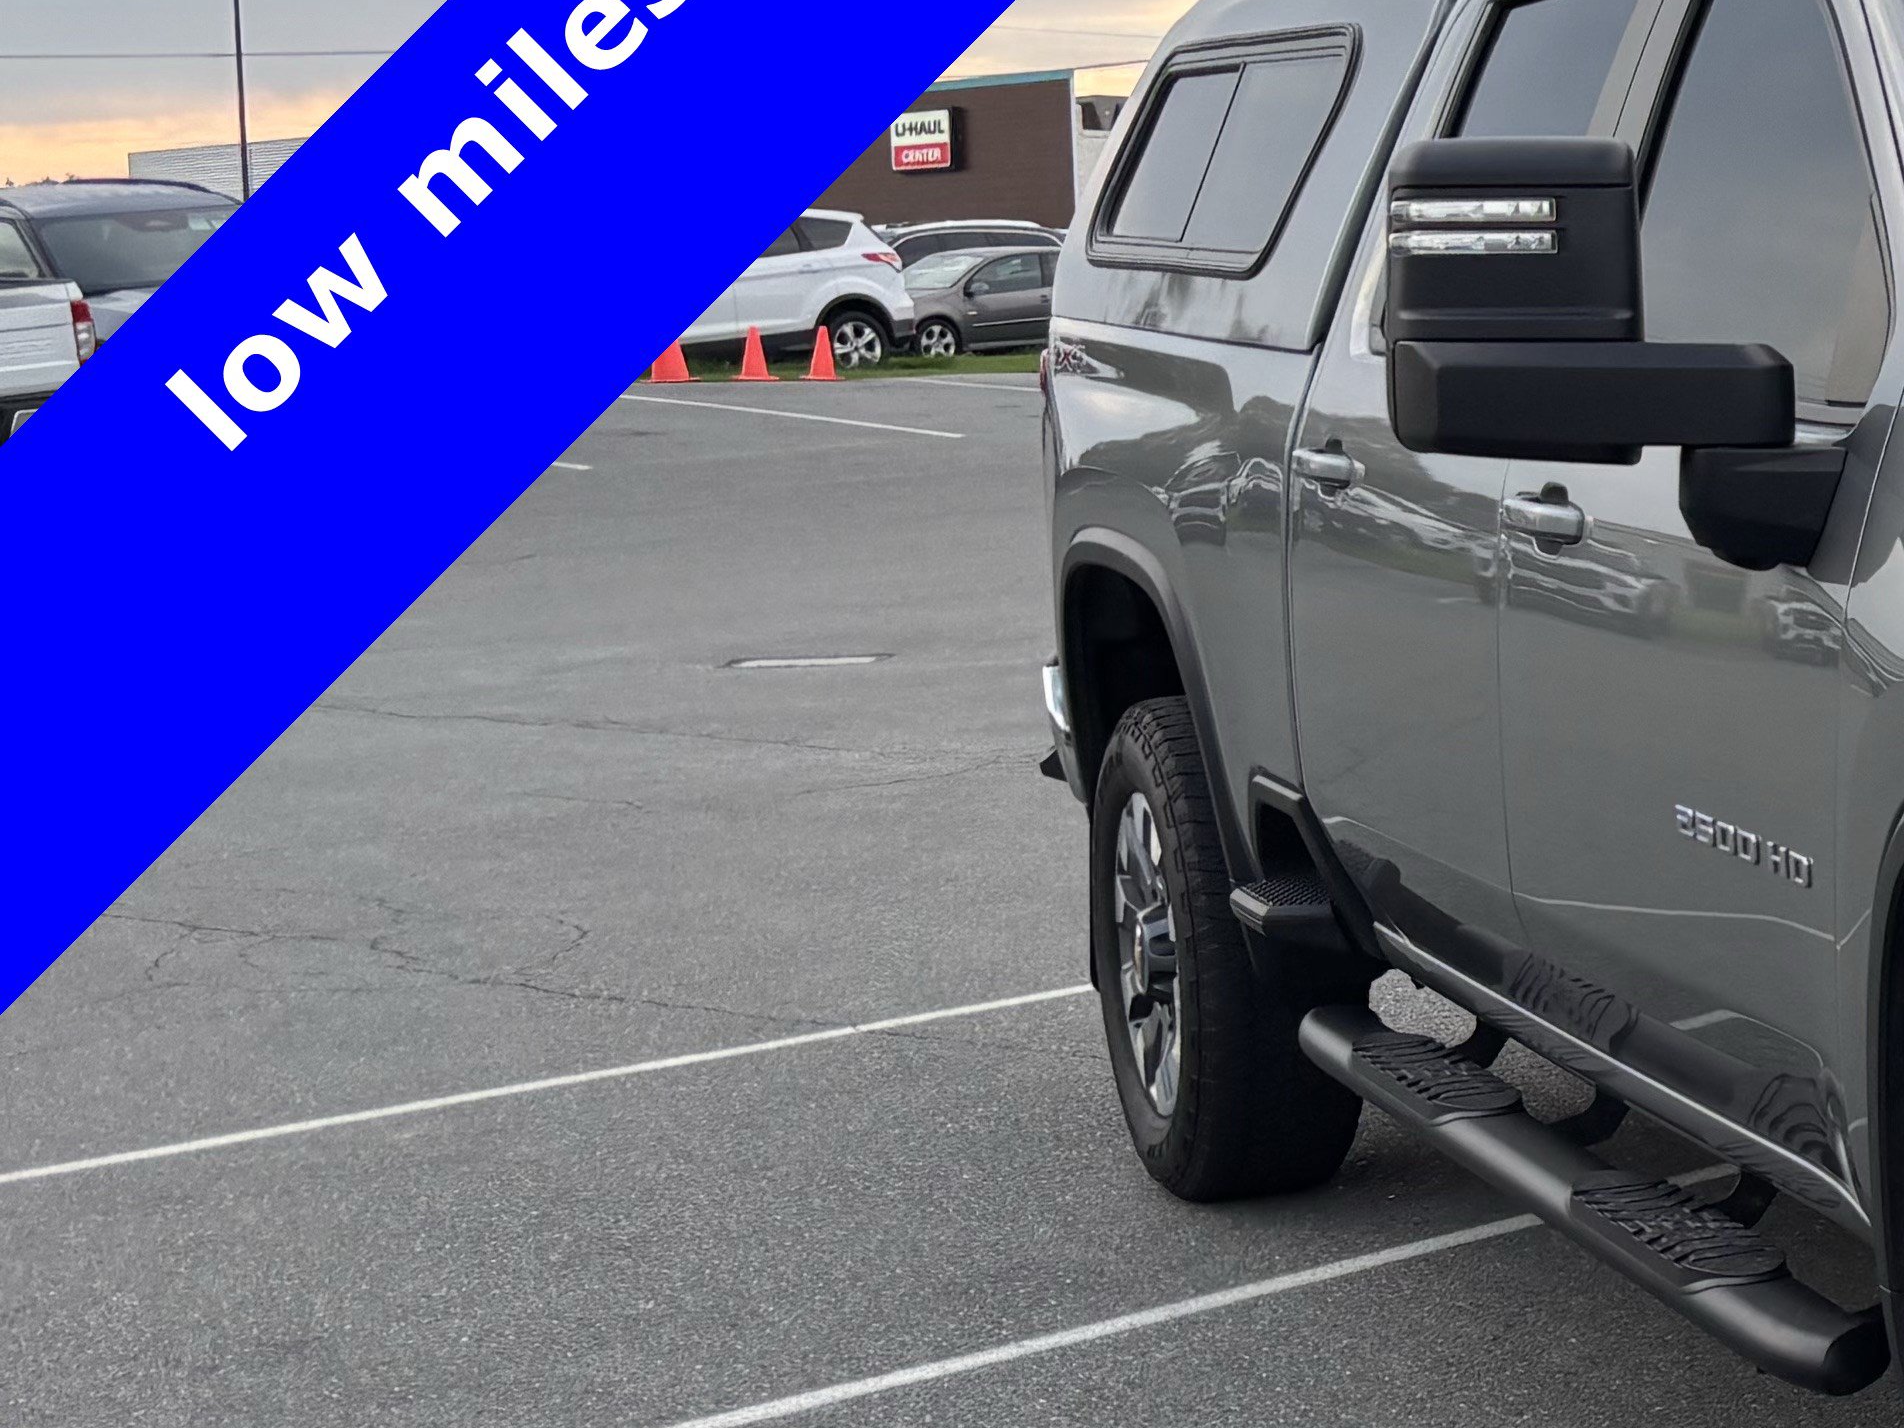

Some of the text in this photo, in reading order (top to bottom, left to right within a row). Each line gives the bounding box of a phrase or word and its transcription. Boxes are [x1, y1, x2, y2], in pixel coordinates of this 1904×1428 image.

[894, 118, 945, 138] U-HAUL
[901, 146, 943, 164] CENTER
[1674, 803, 1814, 889] 2500 HD
